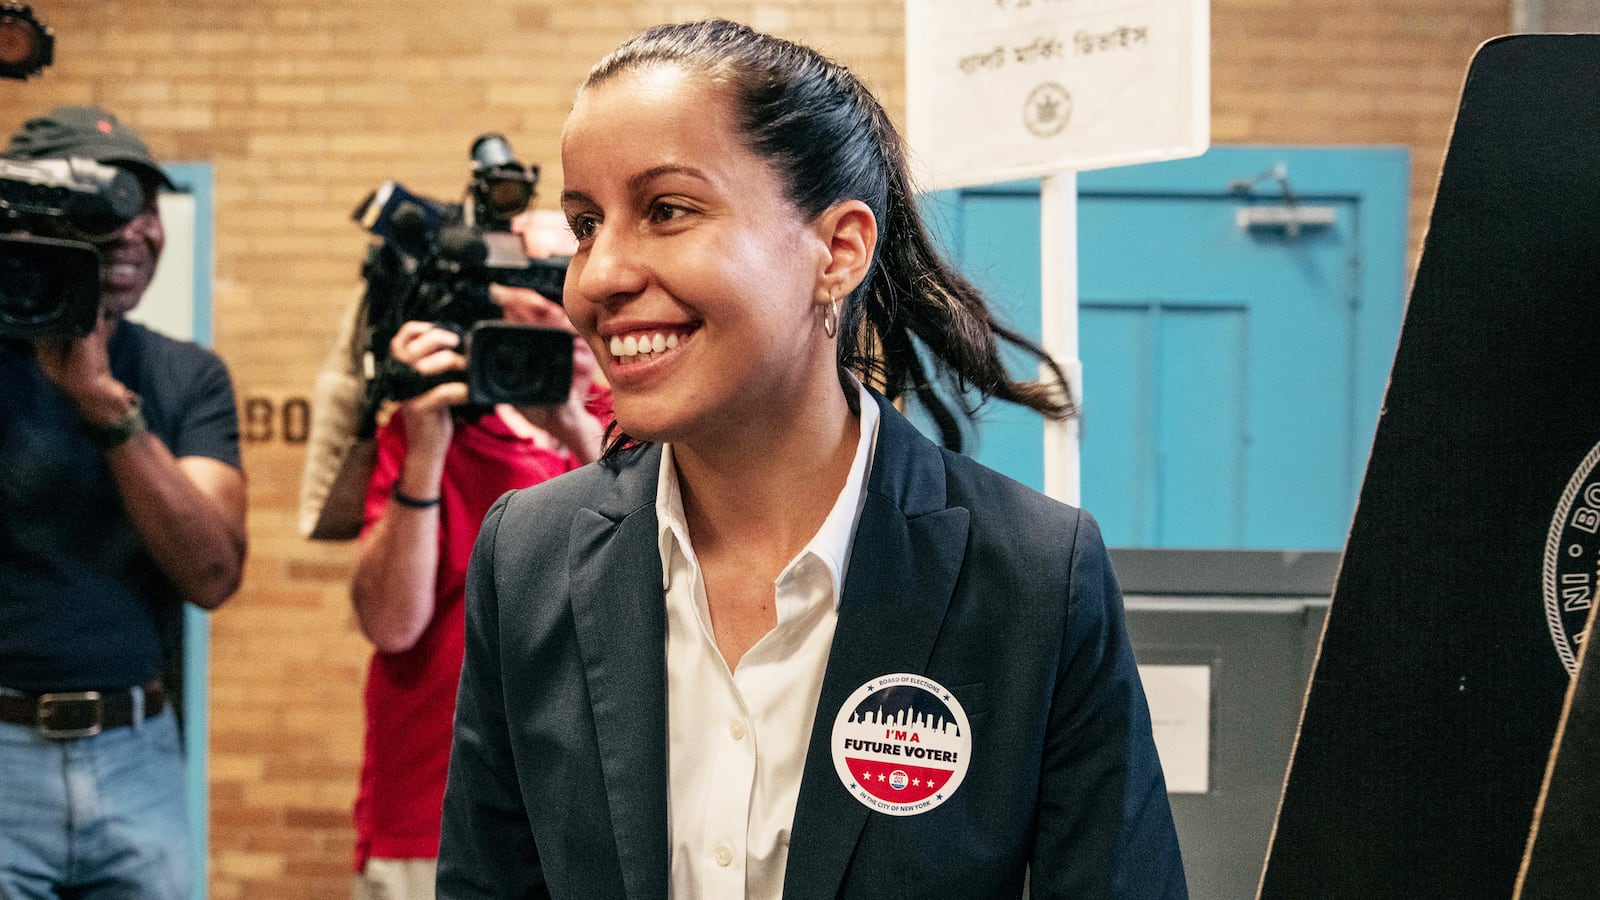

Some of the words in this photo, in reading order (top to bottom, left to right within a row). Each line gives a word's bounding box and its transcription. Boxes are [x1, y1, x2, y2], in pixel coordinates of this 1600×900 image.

[879, 677, 900, 686] BOARD
[910, 678, 941, 693] ELECTIONS
[885, 729, 907, 741] I'M
[909, 732, 920, 743] A
[844, 738, 901, 756] FUTURE
[904, 746, 958, 763] VOTER!
[867, 796, 877, 805] THE
[877, 802, 890, 810] CITY
[914, 800, 931, 809] YORK
